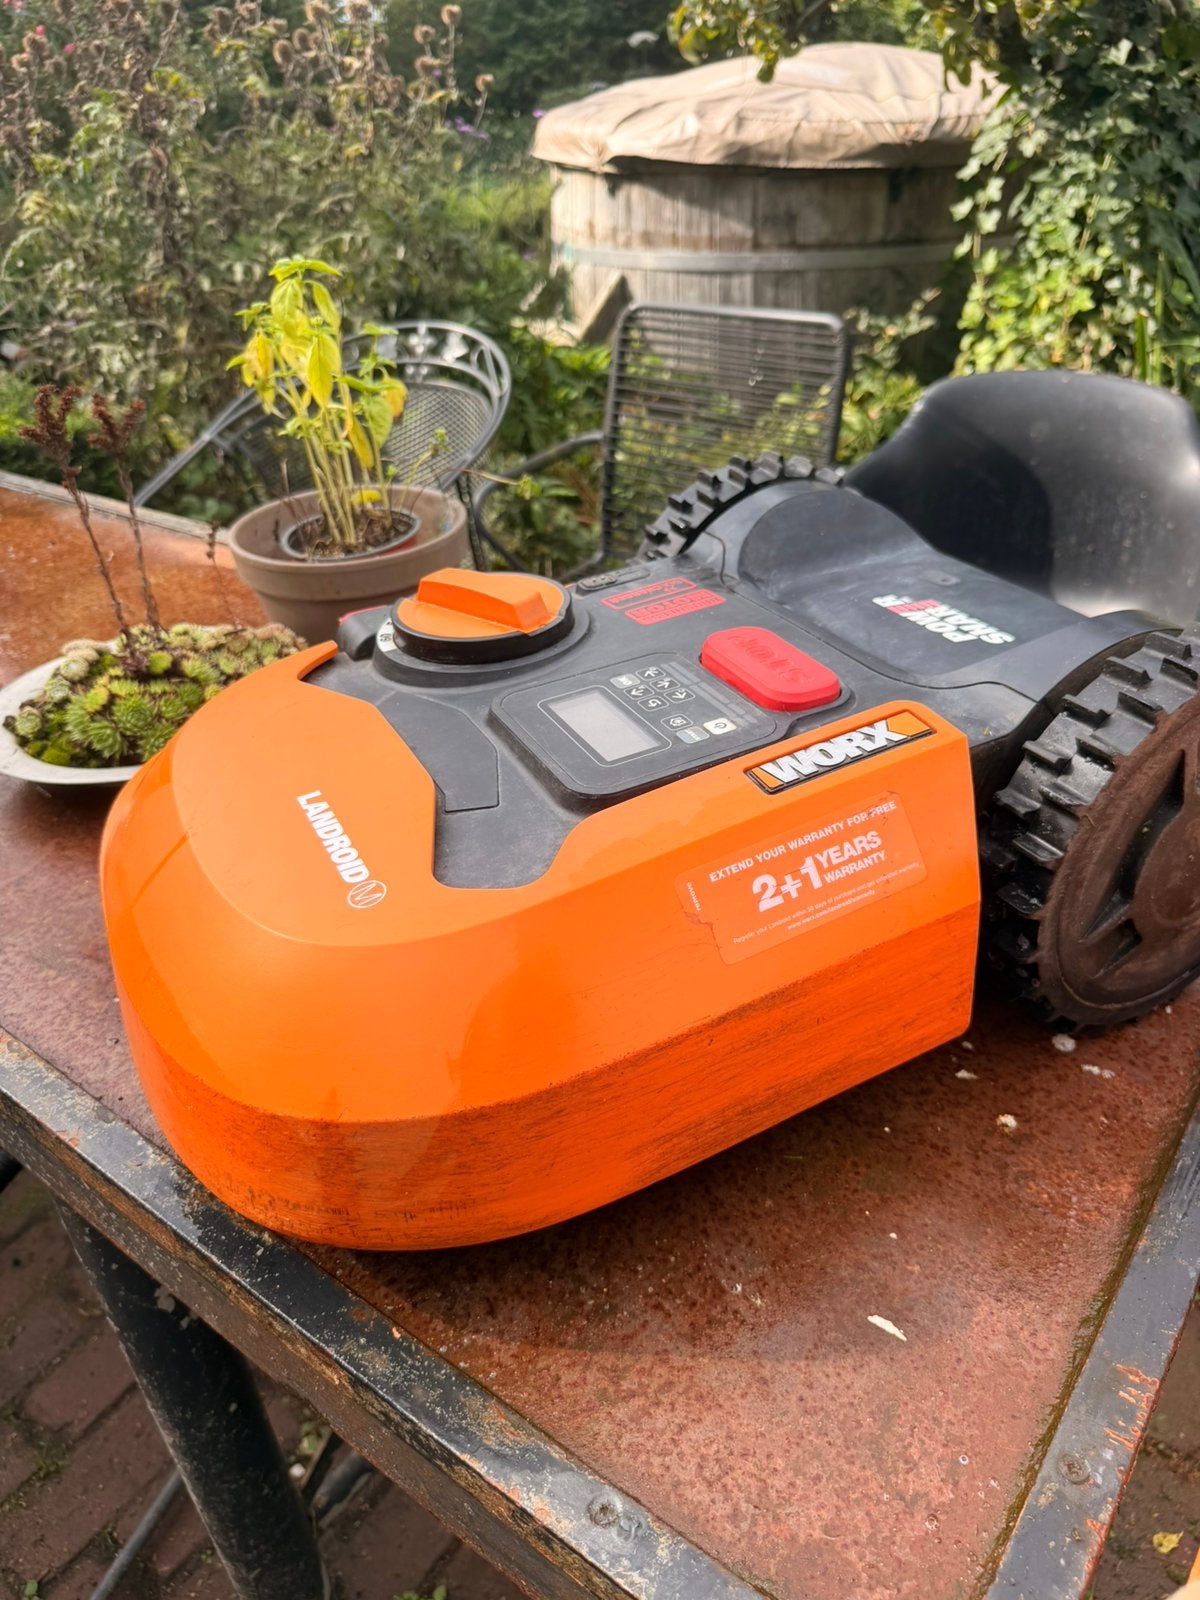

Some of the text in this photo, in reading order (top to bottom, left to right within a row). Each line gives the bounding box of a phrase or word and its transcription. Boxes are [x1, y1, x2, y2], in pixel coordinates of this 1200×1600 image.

[761, 720, 909, 784] WORX
[296, 790, 370, 883] LANDROID
[708, 857, 754, 882] EXTEND
[756, 844, 787, 863] YOUR
[788, 821, 844, 851] WARRANTY
[847, 811, 868, 827] FOR
[752, 831, 882, 912] 2+1 YEARS
[823, 850, 886, 884] WARRANTY
